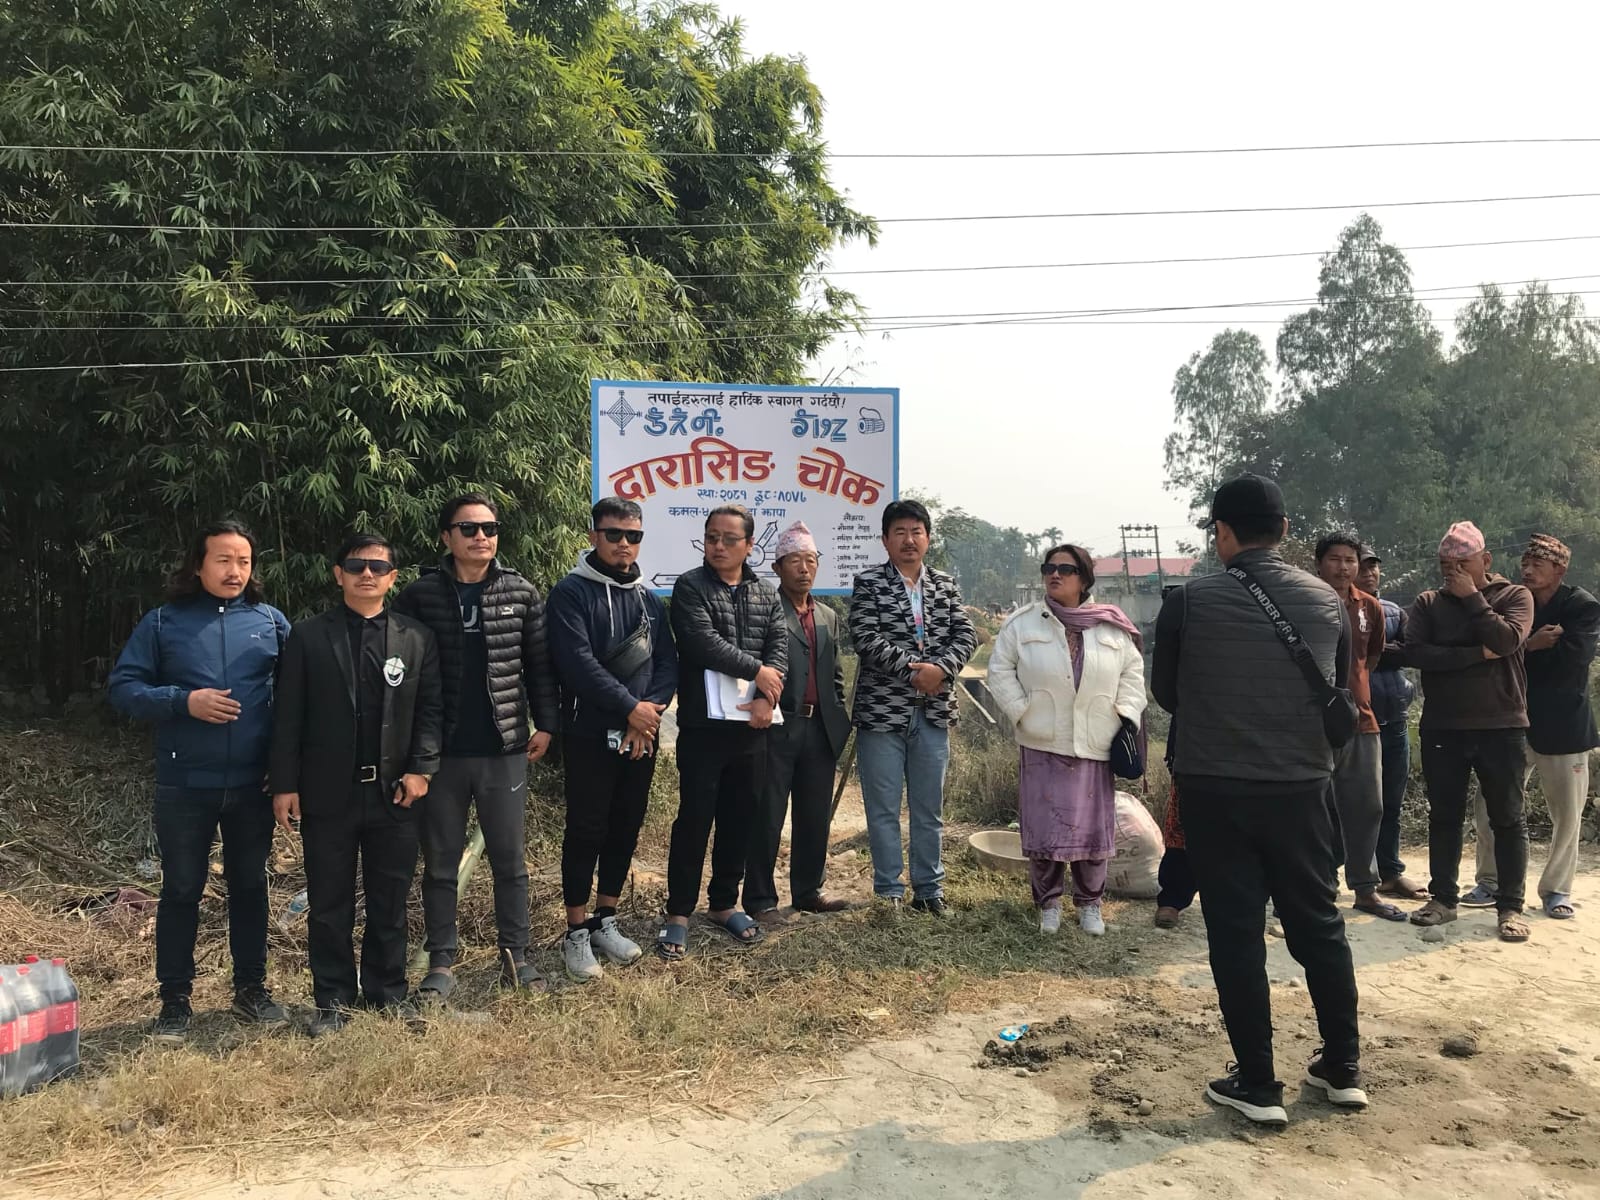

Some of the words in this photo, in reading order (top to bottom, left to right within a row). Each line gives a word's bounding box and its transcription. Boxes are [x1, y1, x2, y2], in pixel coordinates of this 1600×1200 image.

[768, 396, 803, 408] स्वागत
[798, 447, 885, 507] चोक
[761, 508, 786, 517] झापा
[1249, 583, 1280, 620] UNDER
